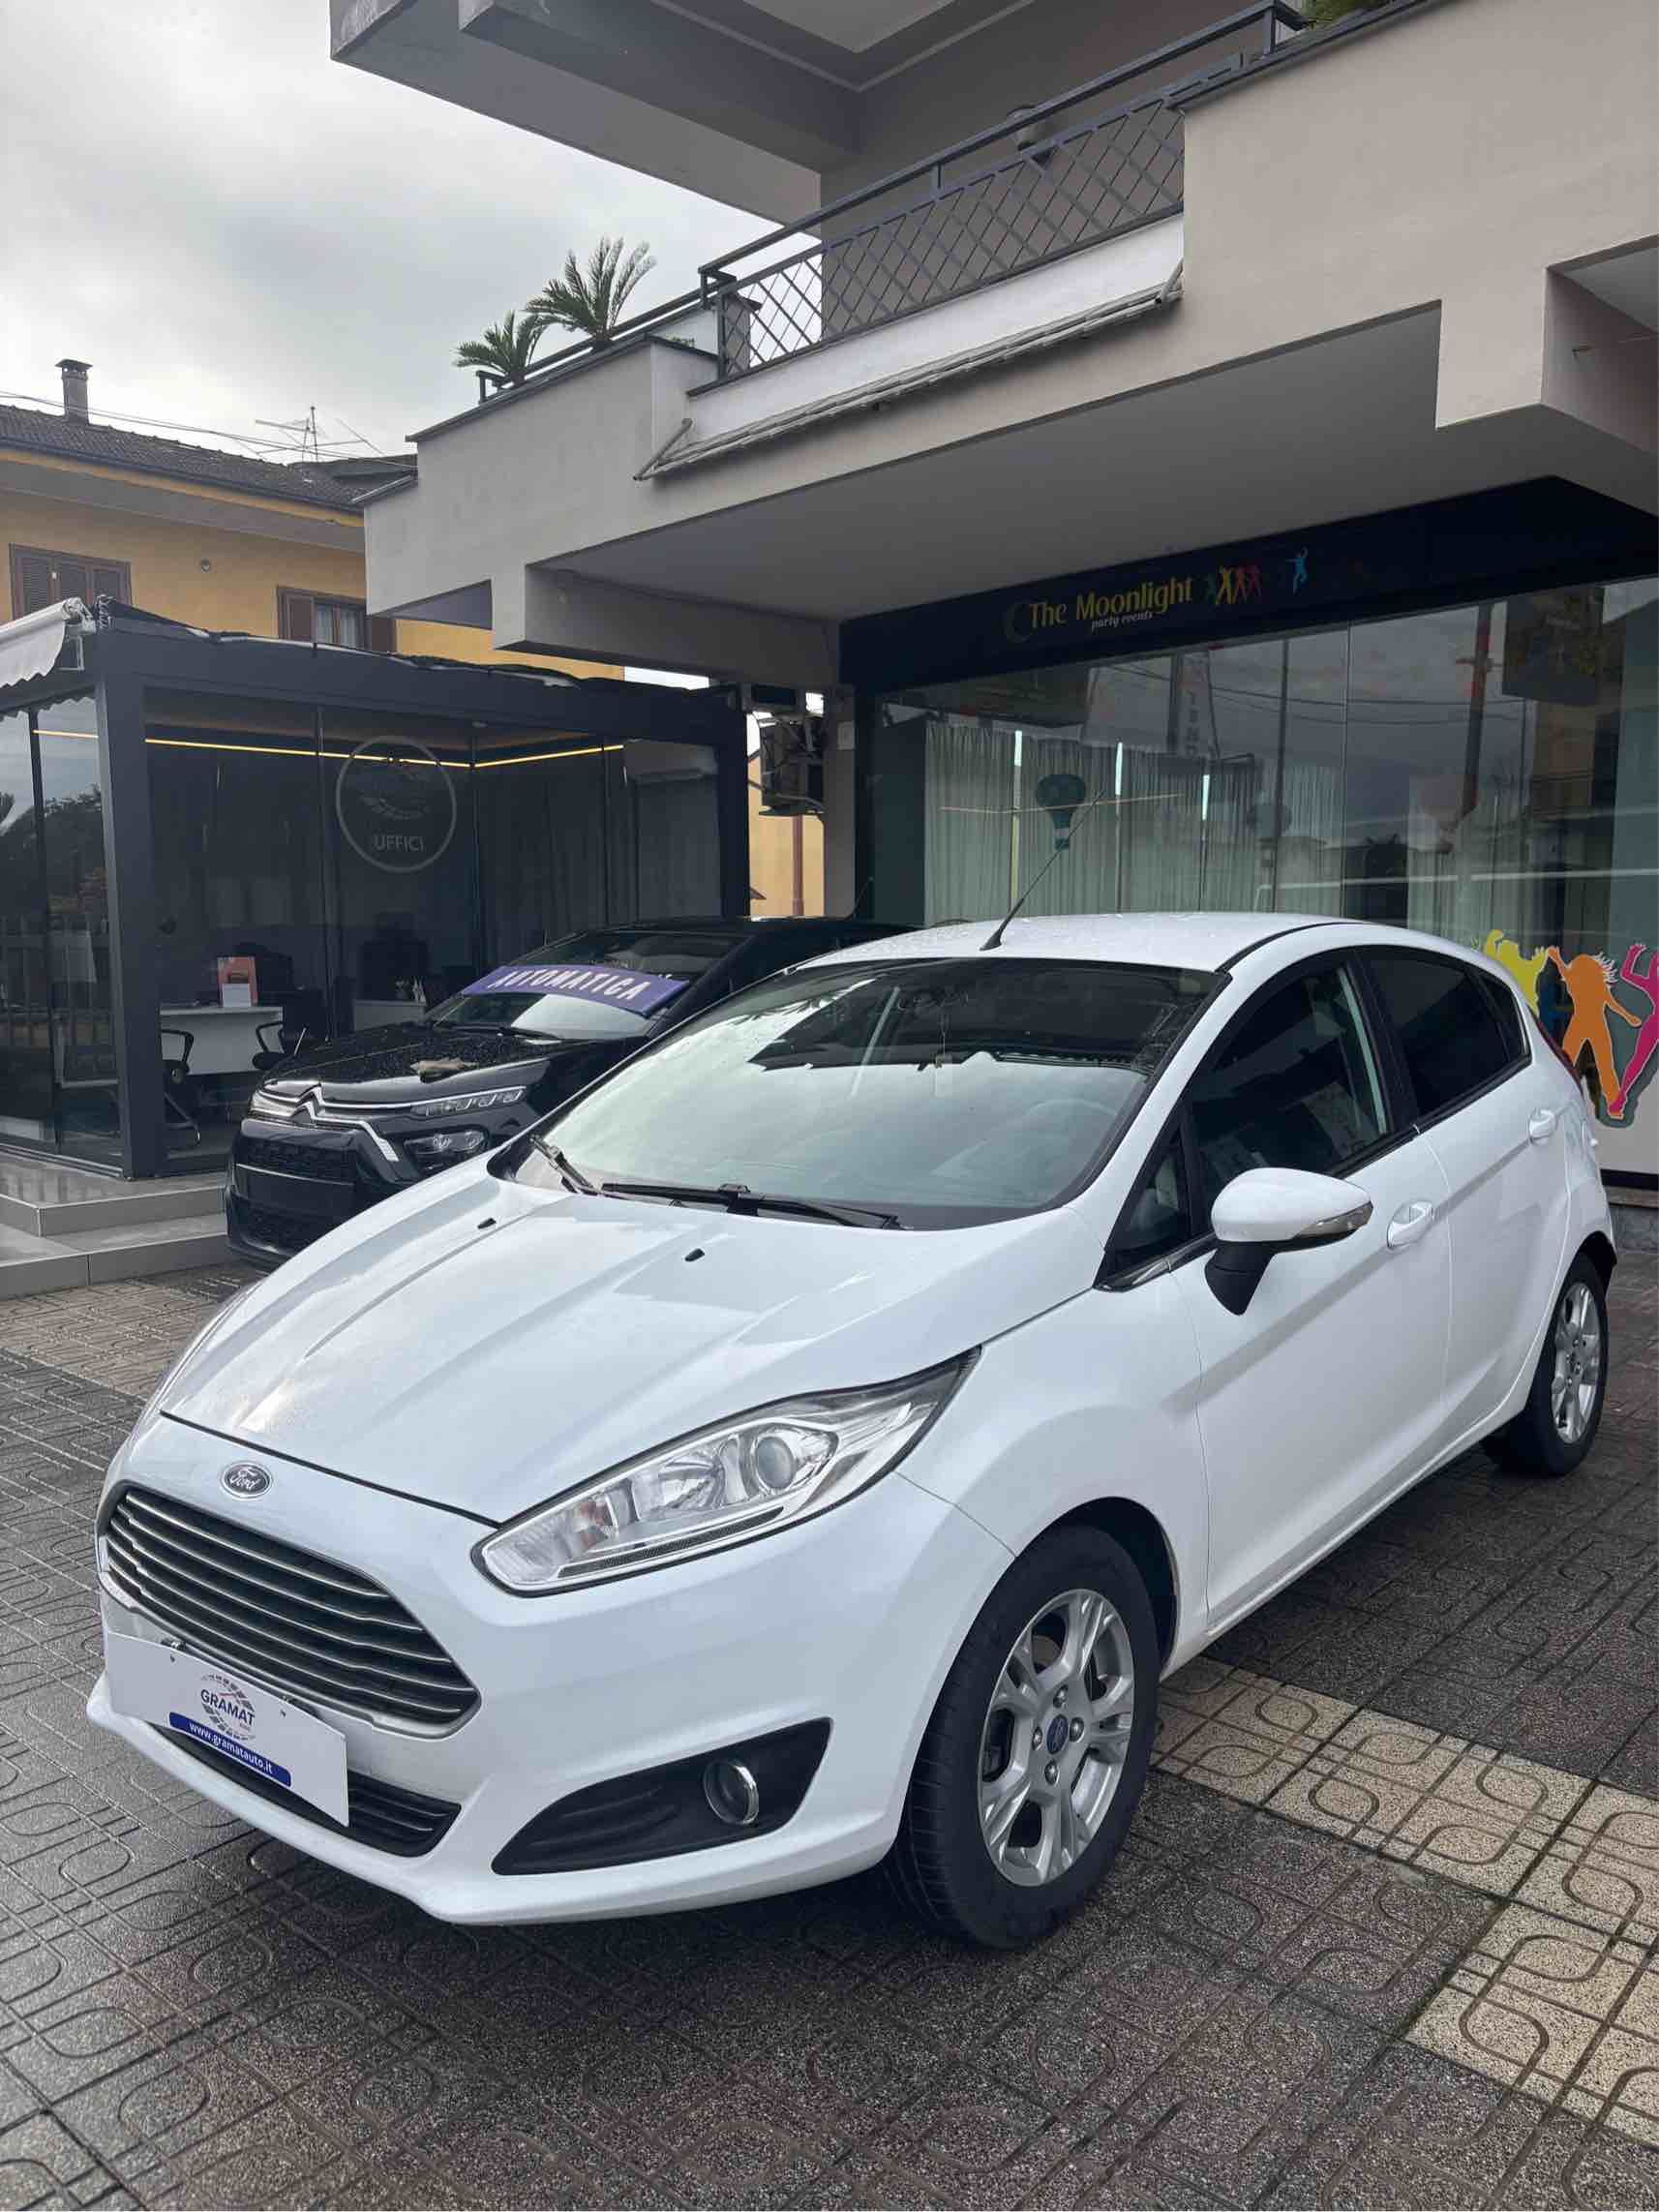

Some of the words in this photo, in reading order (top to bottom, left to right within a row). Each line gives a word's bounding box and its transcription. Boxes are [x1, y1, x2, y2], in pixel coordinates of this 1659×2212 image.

[1029, 600, 1068, 629] The
[1075, 577, 1192, 620] Moonlight
[1091, 615, 1119, 630] party
[1121, 610, 1154, 622] events
[375, 834, 426, 852] UFFICI
[487, 968, 651, 1000] AUTOMATICA
[229, 1467, 261, 1491] Ford
[200, 1688, 256, 1726] GRAMAT
[189, 1721, 273, 1774] www.gramatauto.it
